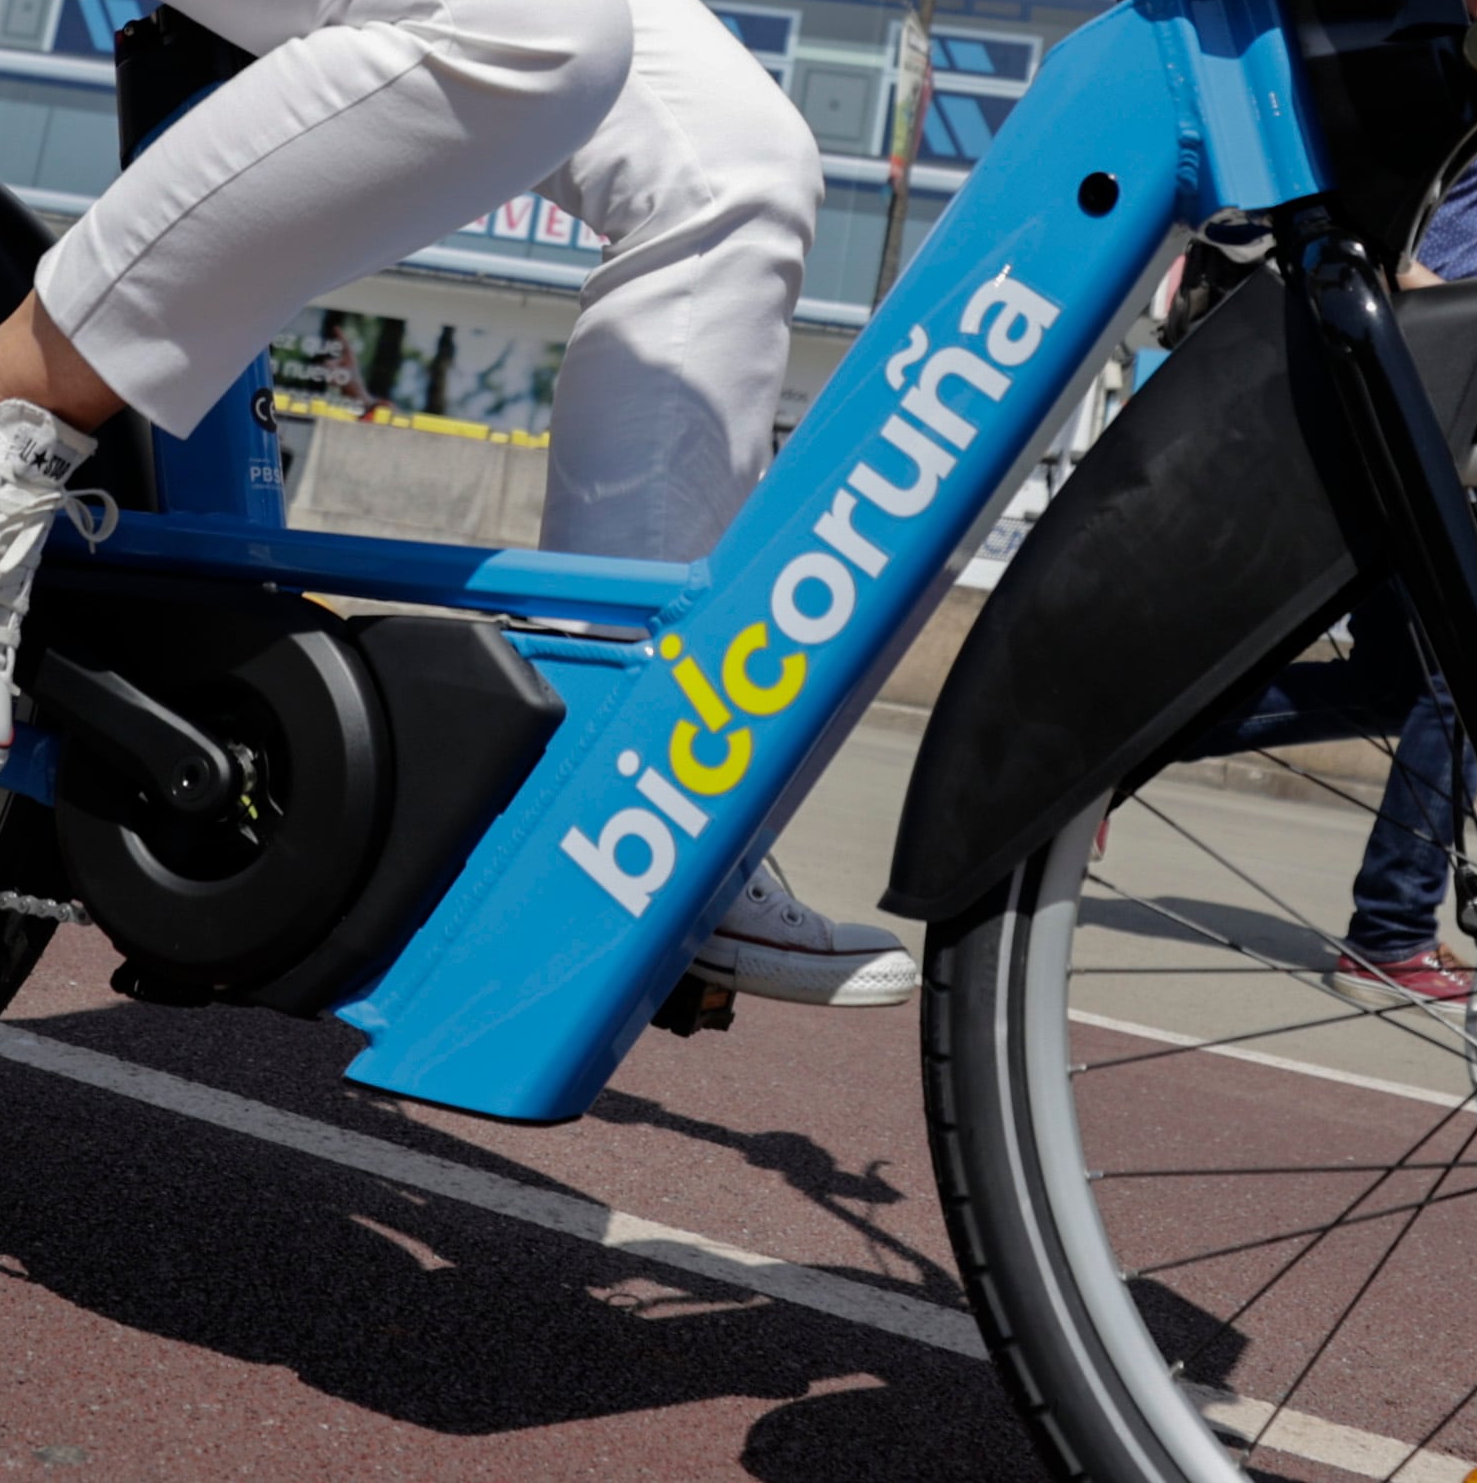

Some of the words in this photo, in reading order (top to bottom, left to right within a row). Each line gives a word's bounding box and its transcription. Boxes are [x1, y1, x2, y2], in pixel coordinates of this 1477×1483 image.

[273, 333, 298, 350] ez
[301, 335, 344, 358] que
[283, 359, 352, 386] nuevo
[559, 275, 1061, 919] bicicoruña
